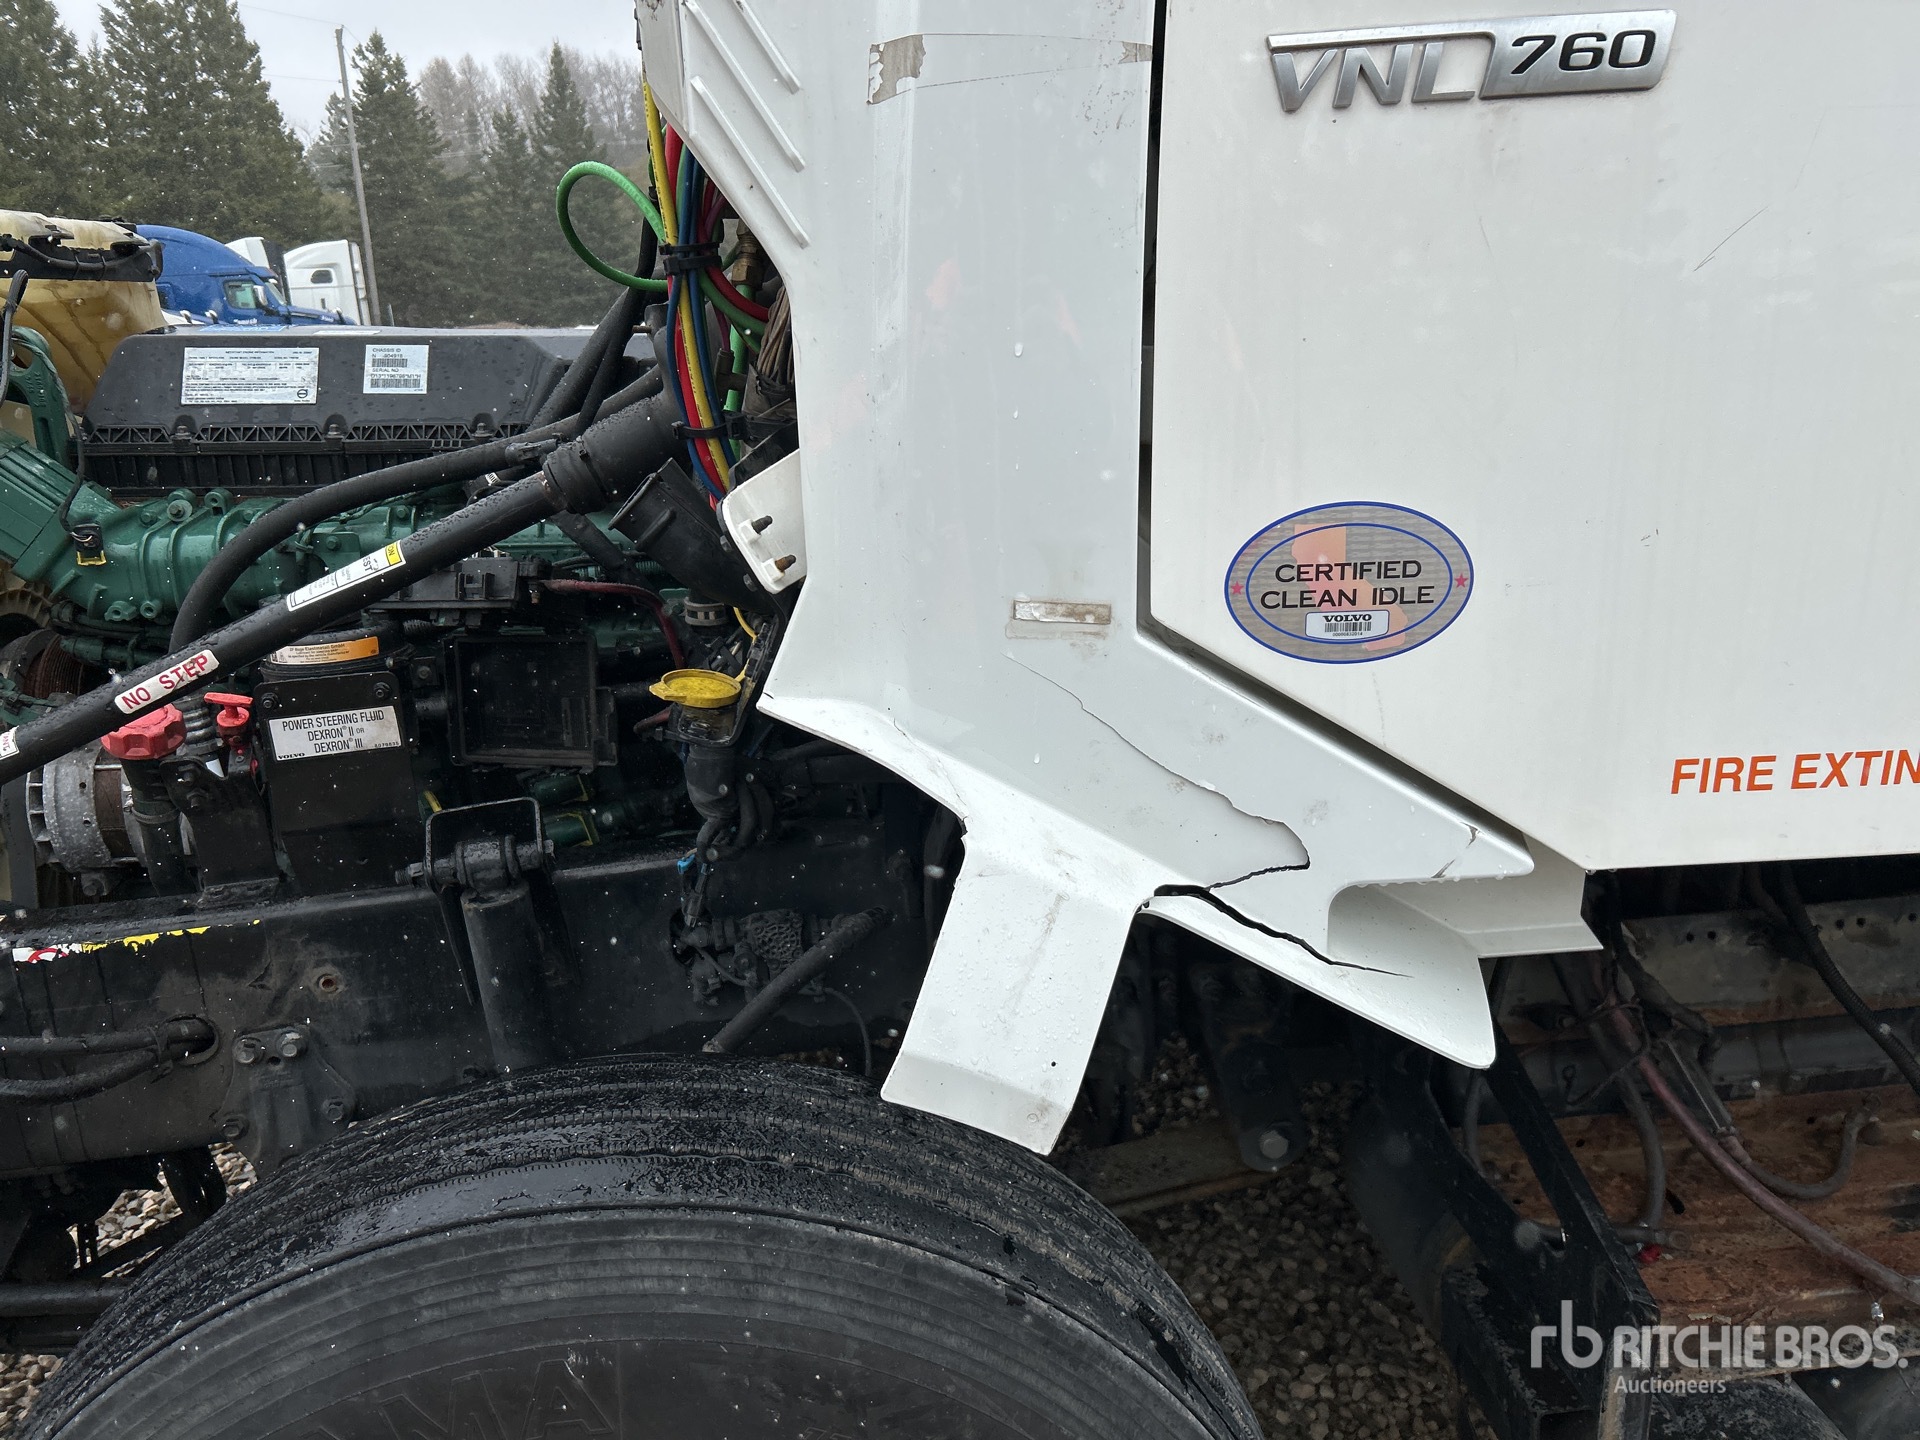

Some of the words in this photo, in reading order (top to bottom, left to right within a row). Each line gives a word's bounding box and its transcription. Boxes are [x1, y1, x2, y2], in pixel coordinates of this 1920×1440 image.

[1272, 42, 1477, 113] VNL
[1511, 30, 1657, 75] 760
[1275, 560, 1422, 583] CERTIFIED
[1260, 588, 1357, 610] CLEAN
[1372, 585, 1435, 606] IDLE
[1322, 613, 1373, 623] VOLVO
[121, 687, 152, 710] NO
[159, 654, 208, 690] STEP
[282, 720, 314, 731] POWER
[316, 713, 359, 728] STEERING
[360, 710, 385, 723] FLUID
[348, 726, 355, 736] II
[355, 738, 363, 748] III
[1670, 755, 1777, 795] FIRE
[1790, 749, 1920, 790] EXTIN
